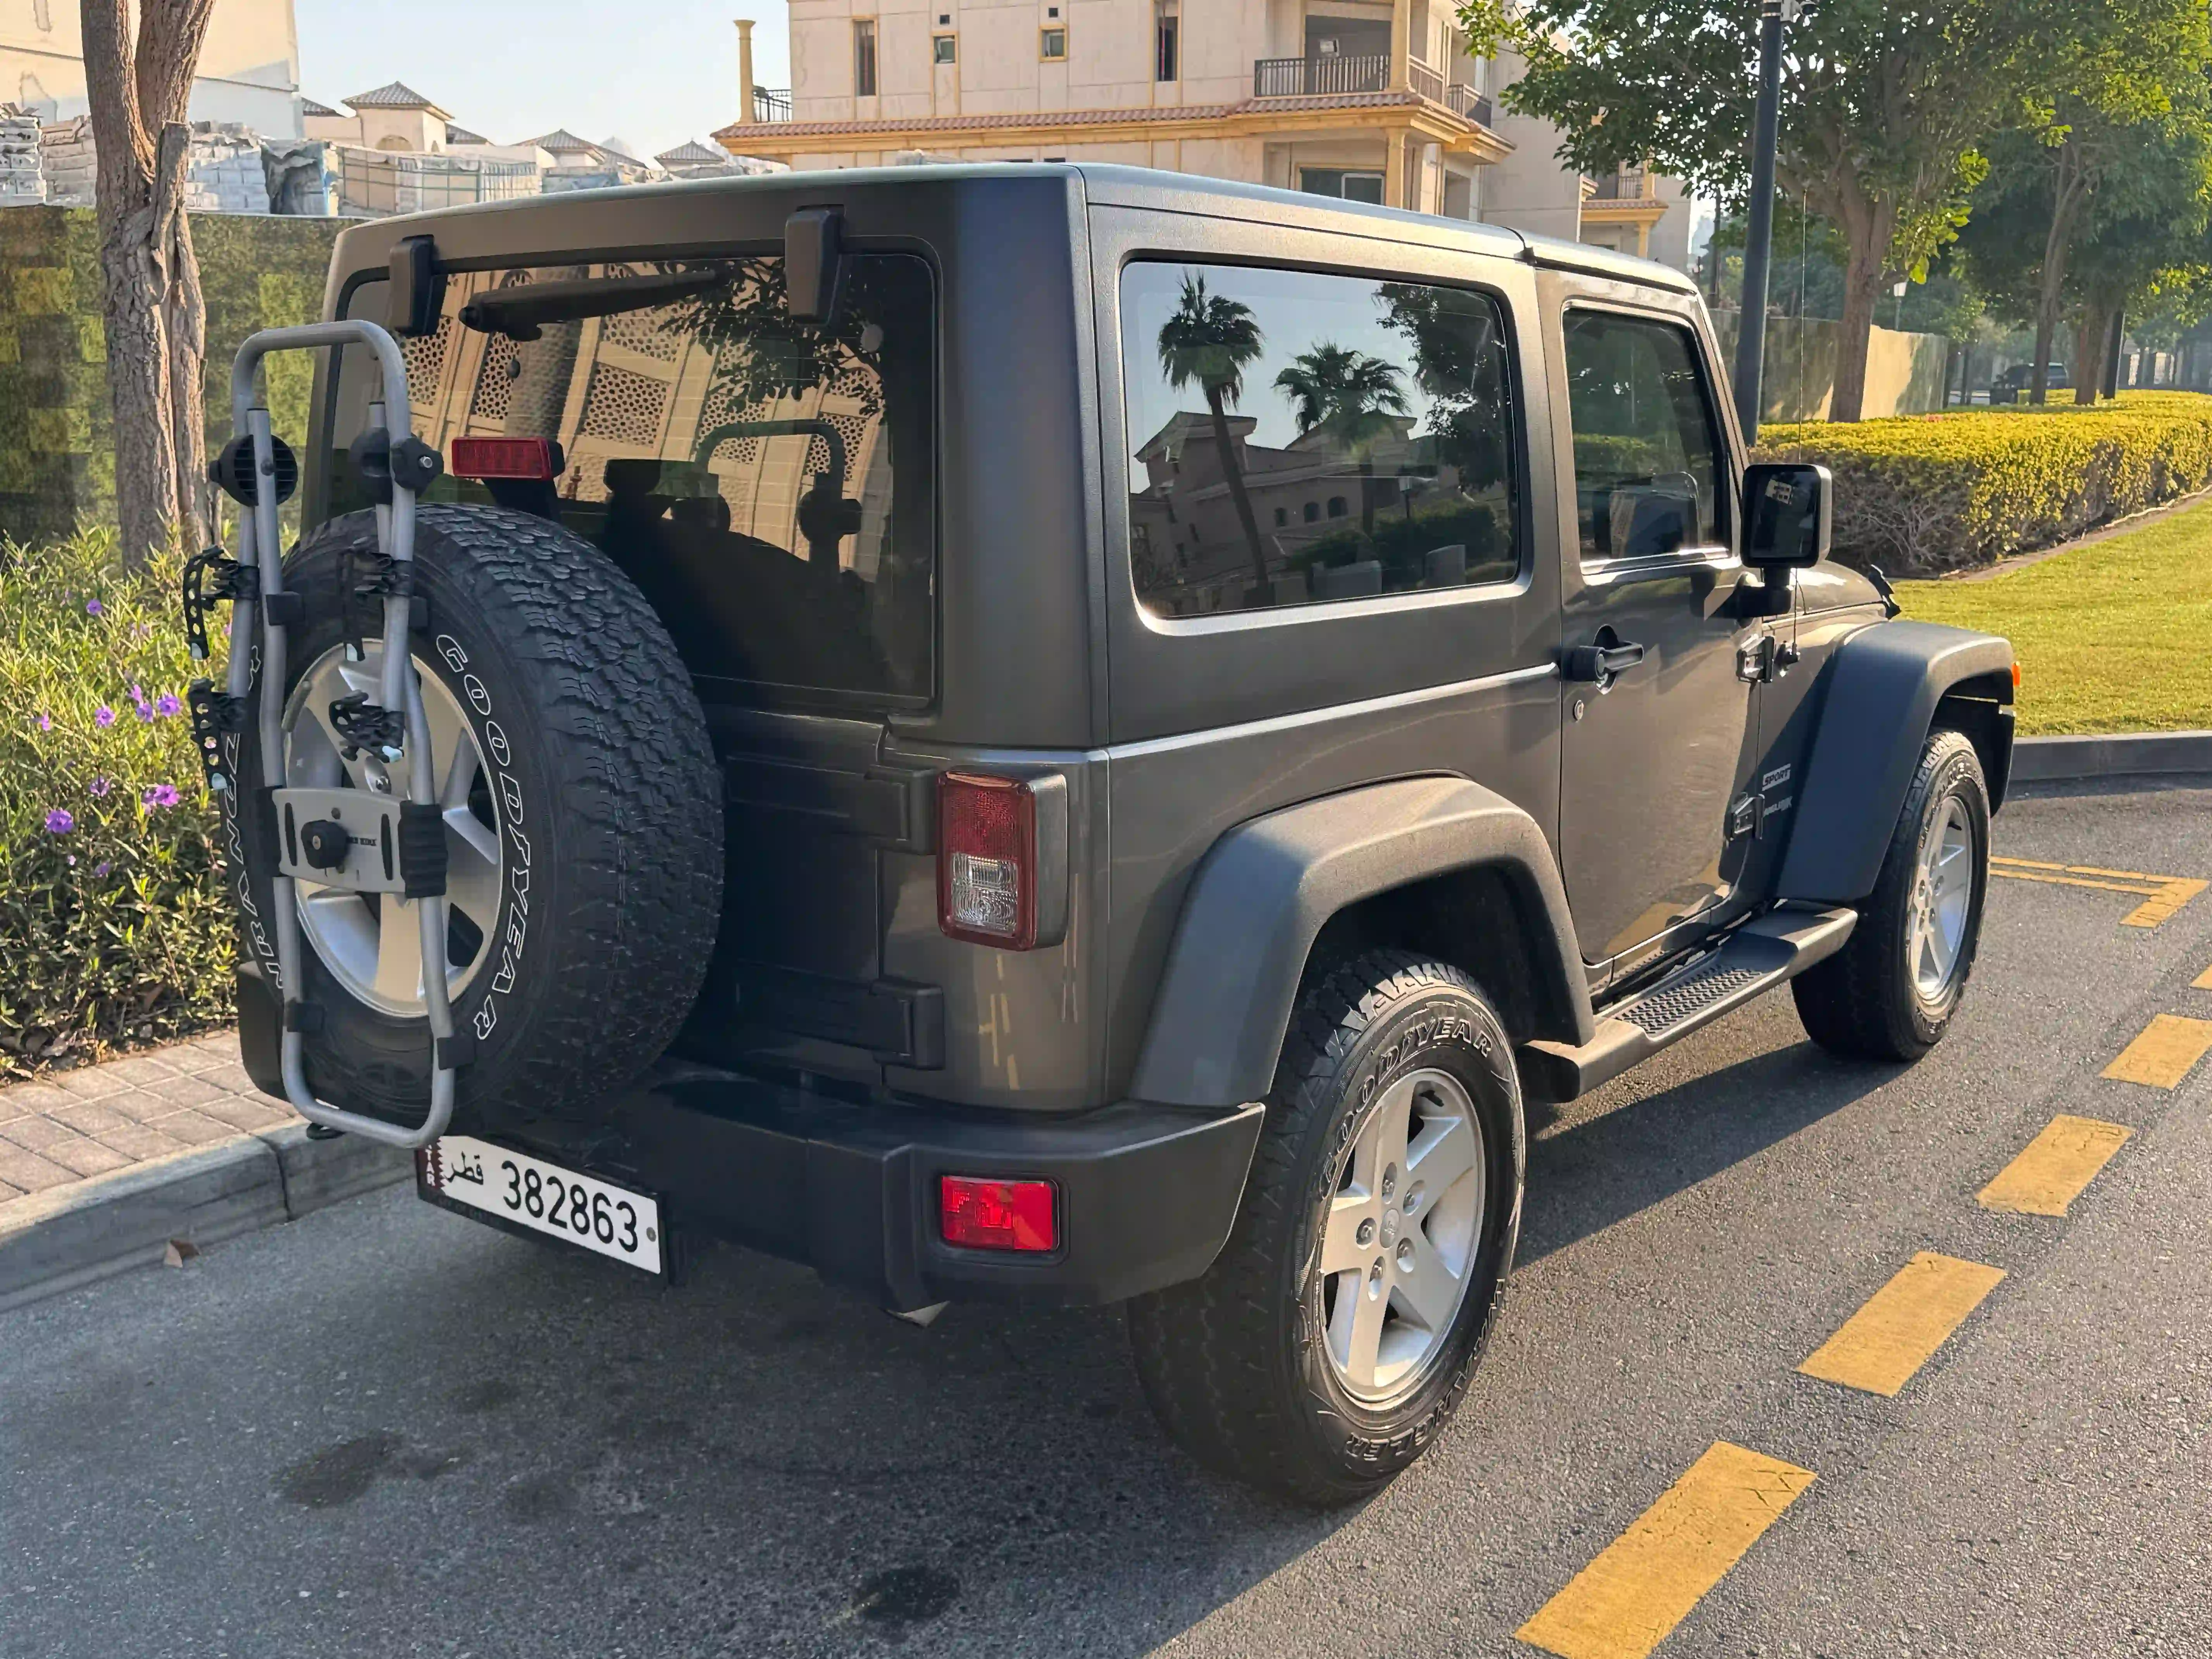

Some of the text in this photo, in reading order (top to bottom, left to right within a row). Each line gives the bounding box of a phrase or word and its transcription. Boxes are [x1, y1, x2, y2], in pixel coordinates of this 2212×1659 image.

[1763, 767, 1791, 787] SPORT
[436, 635, 530, 1040] GOODYEAR
[1319, 1016, 1492, 1201] GOODYEAR
[443, 1150, 484, 1185] قطر
[501, 1161, 638, 1253] 382863
